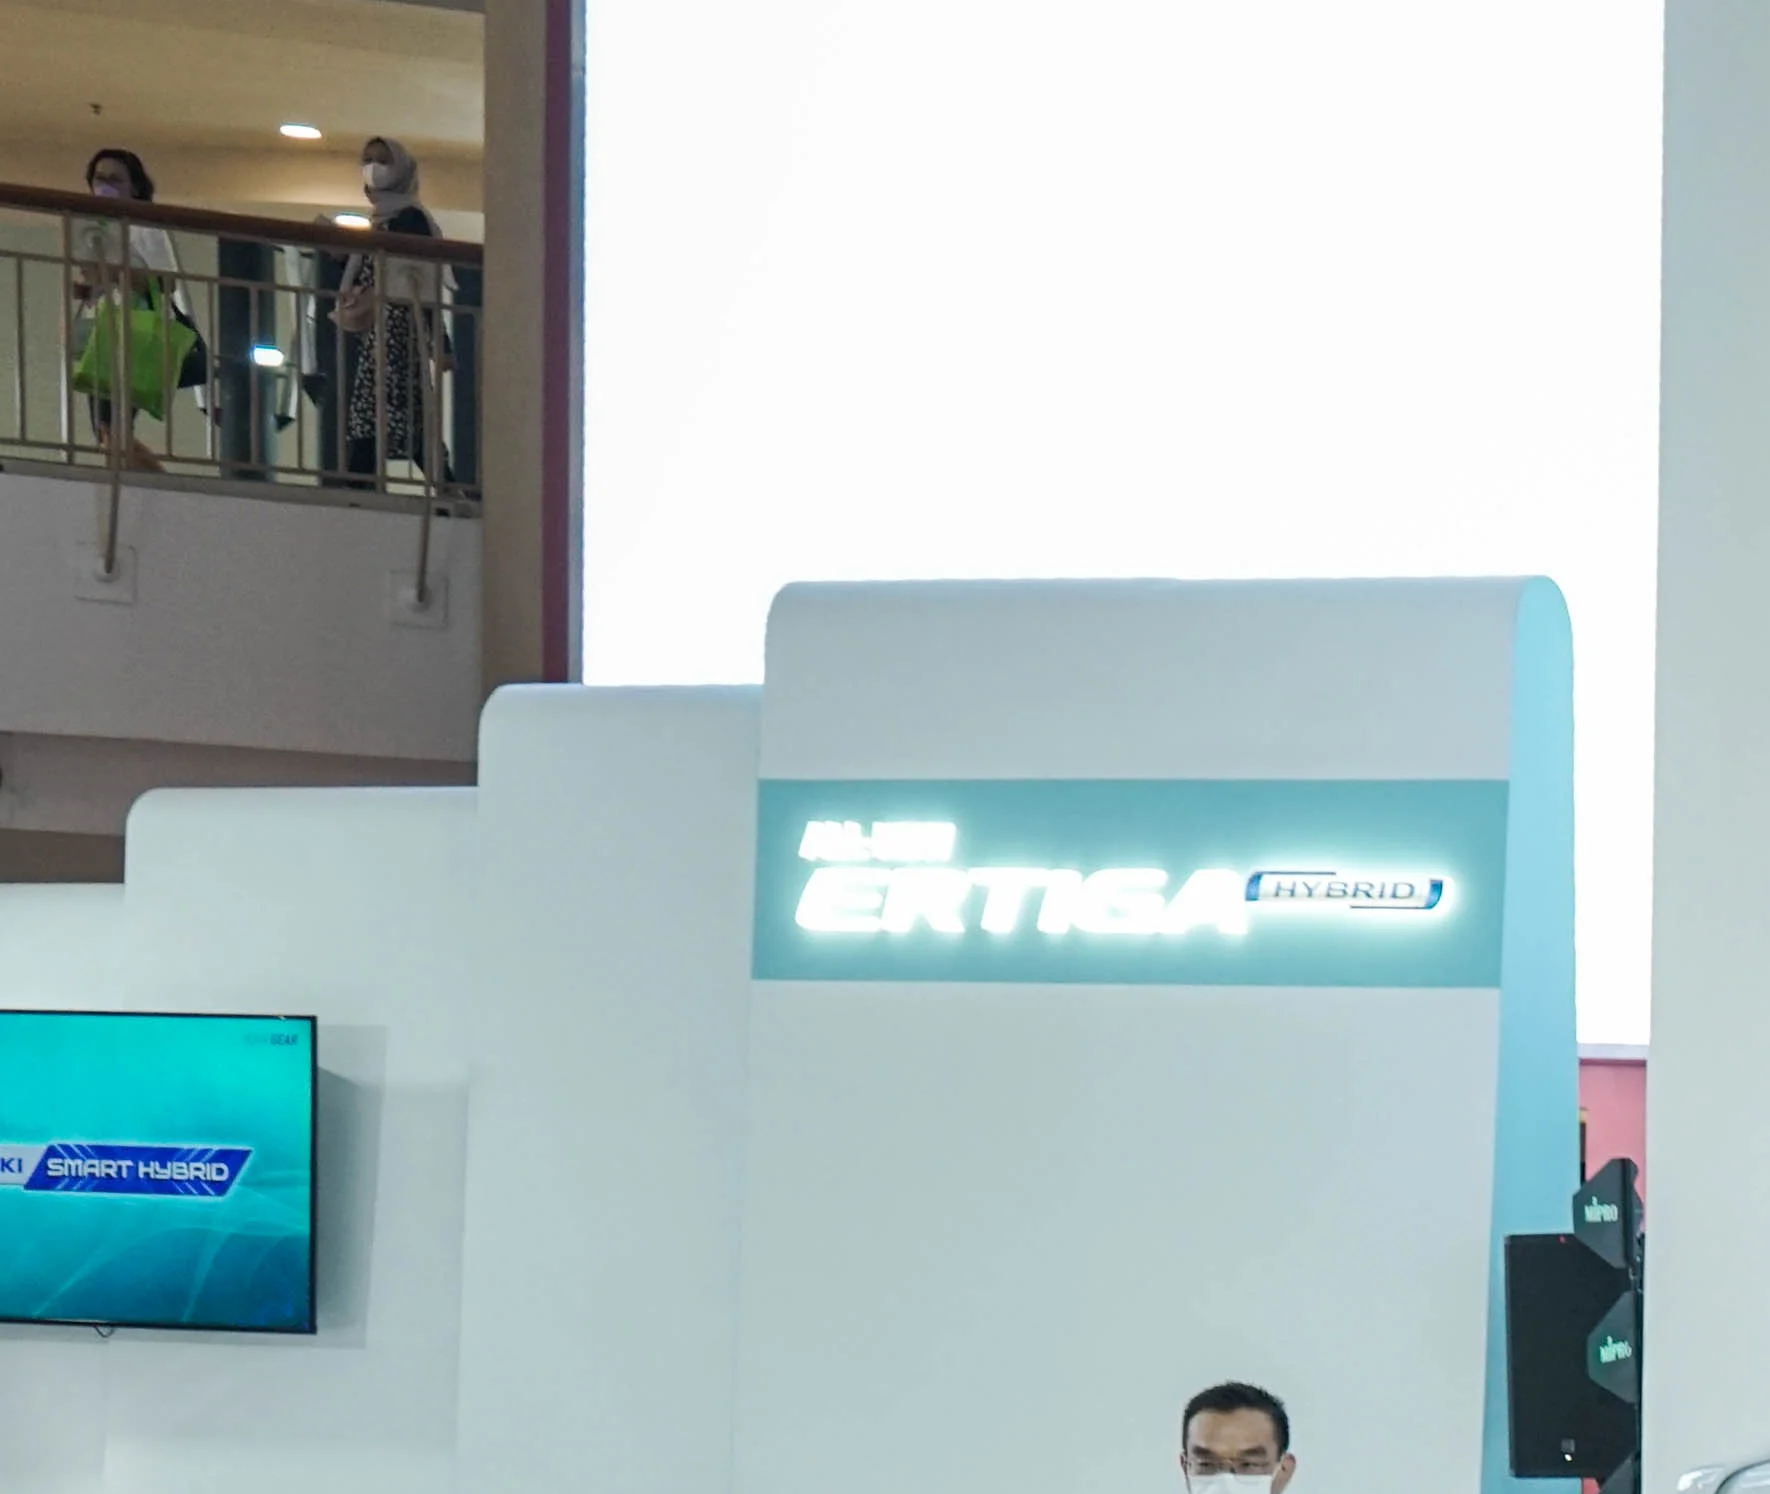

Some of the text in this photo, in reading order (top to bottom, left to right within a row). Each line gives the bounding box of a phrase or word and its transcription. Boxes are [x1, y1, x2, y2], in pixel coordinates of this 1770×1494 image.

[795, 866, 1416, 934] ERTIGA HYBRID
[46, 1158, 135, 1178] SMART
[138, 1160, 230, 1182] HYBRID
